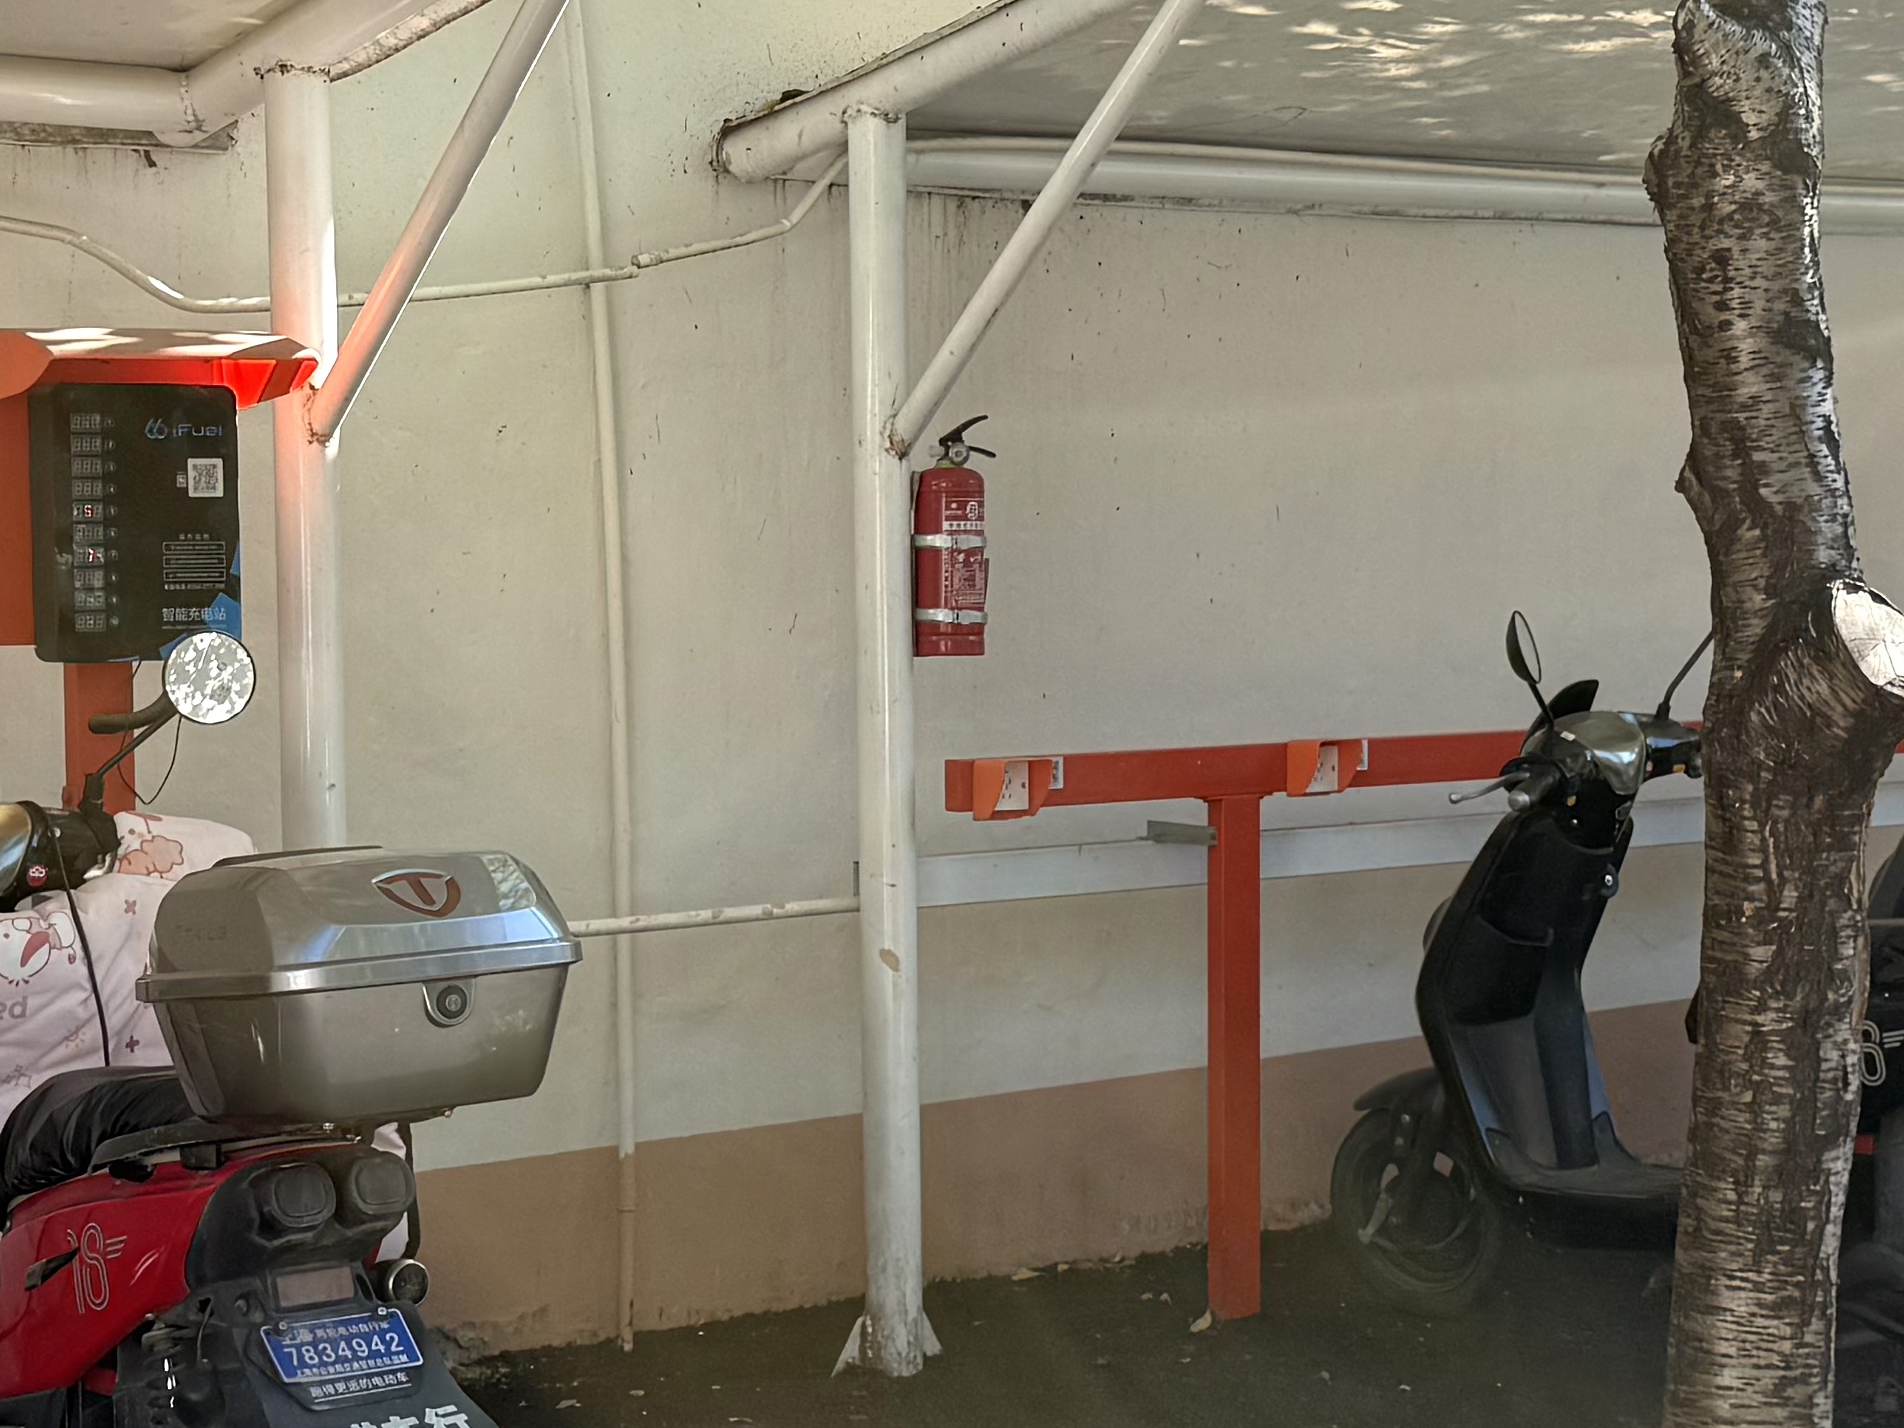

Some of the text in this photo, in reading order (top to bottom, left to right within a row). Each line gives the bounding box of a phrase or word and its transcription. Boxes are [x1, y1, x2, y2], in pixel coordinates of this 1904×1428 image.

[161, 607, 227, 622] 智能充电站
[283, 1333, 404, 1367] 7834942
